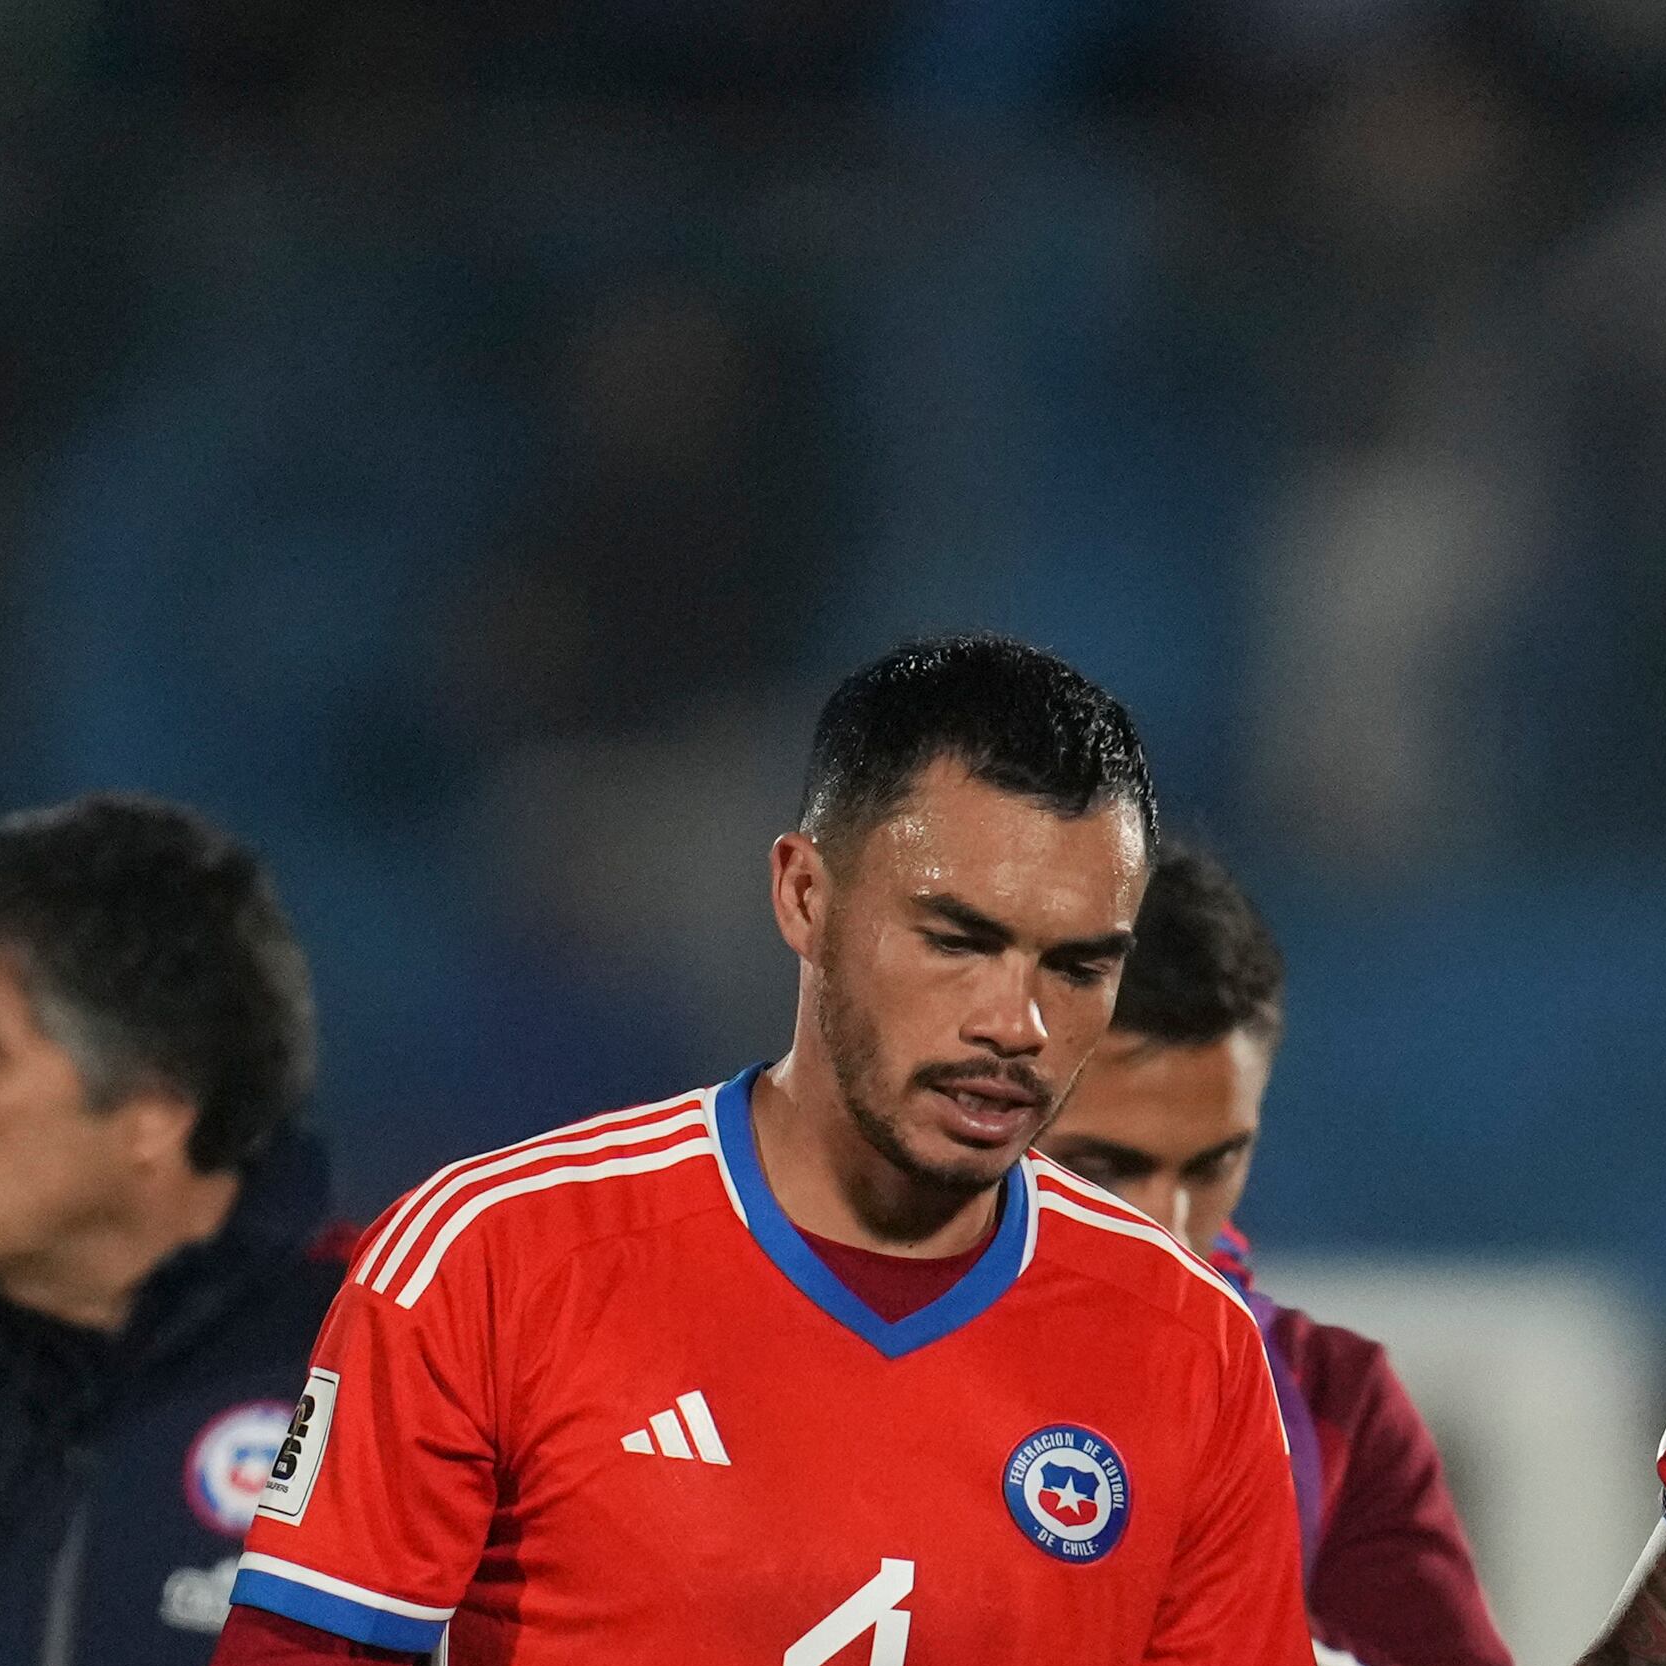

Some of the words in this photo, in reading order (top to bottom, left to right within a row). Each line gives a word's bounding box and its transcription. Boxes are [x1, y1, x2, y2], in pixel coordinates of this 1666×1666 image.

[1008, 1432, 1075, 1486] FEDERACION
[1082, 1438, 1102, 1459] DE
[1101, 1457, 1126, 1510] FUTBOL
[1037, 1531, 1056, 1548] DE
[1062, 1540, 1097, 1556] CHILE
